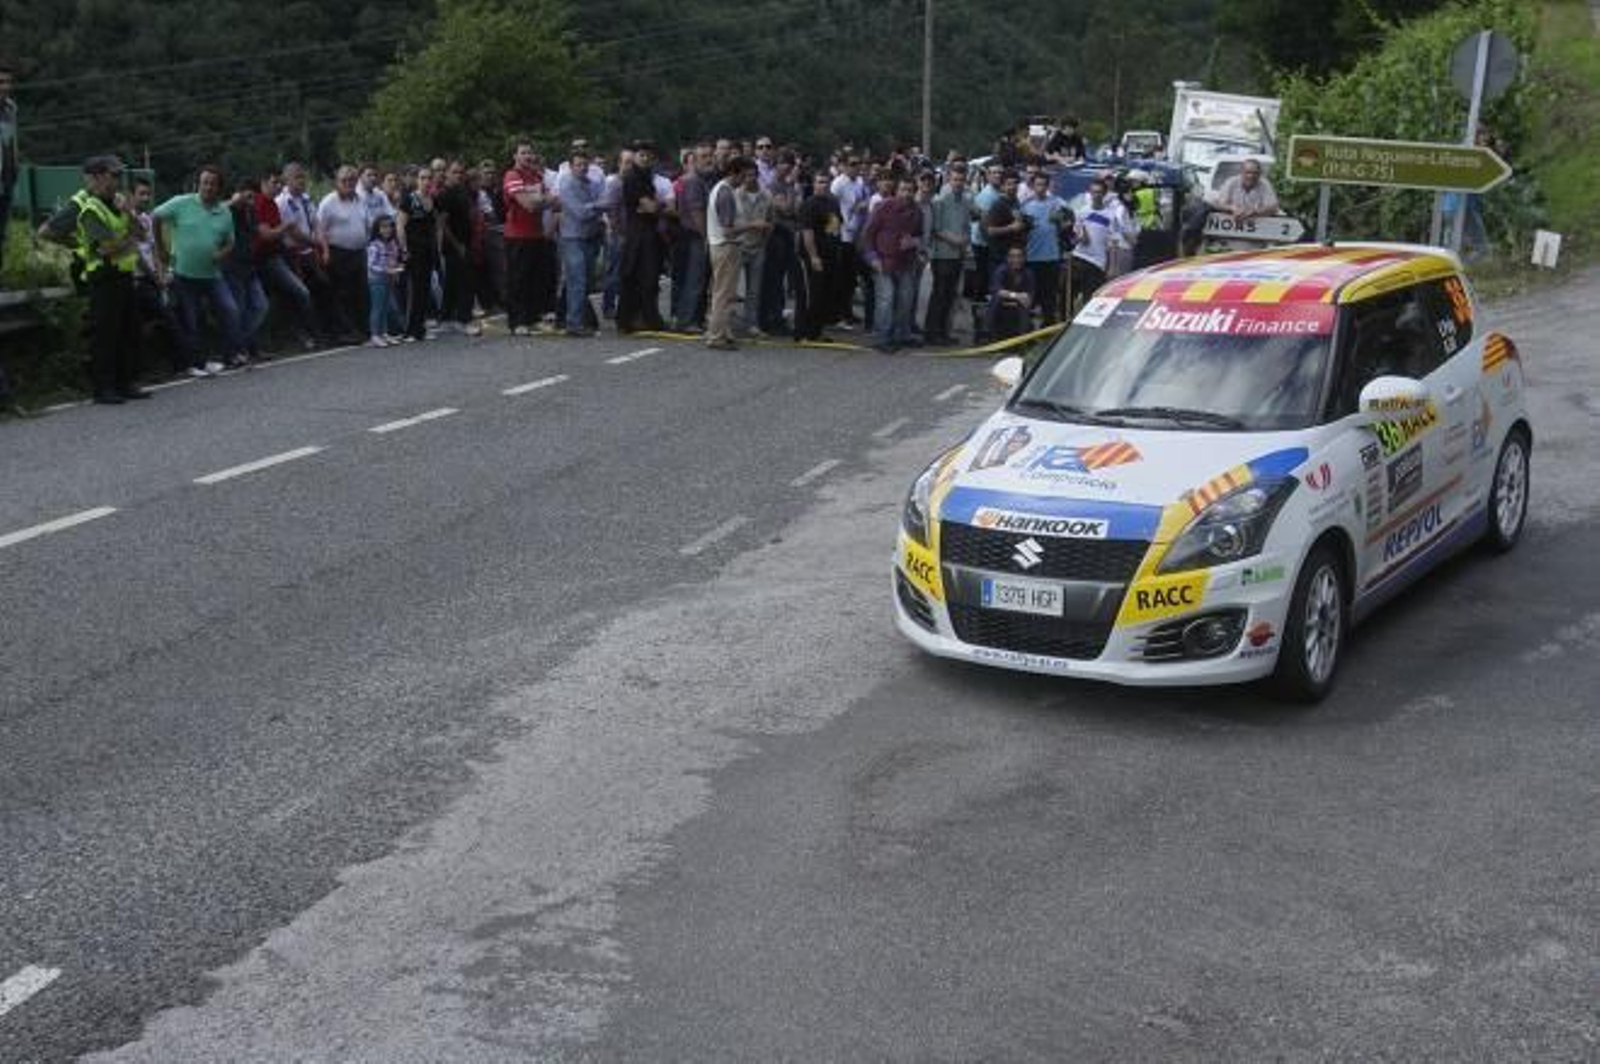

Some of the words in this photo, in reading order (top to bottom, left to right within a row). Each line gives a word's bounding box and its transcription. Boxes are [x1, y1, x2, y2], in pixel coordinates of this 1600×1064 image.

[1325, 145, 1358, 160] Ruta
[1207, 217, 1256, 233] NORS
[1280, 221, 1291, 235] 2
[1235, 318, 1320, 334] Finance
[906, 551, 935, 585] RACC
[1136, 585, 1194, 611] RACC
